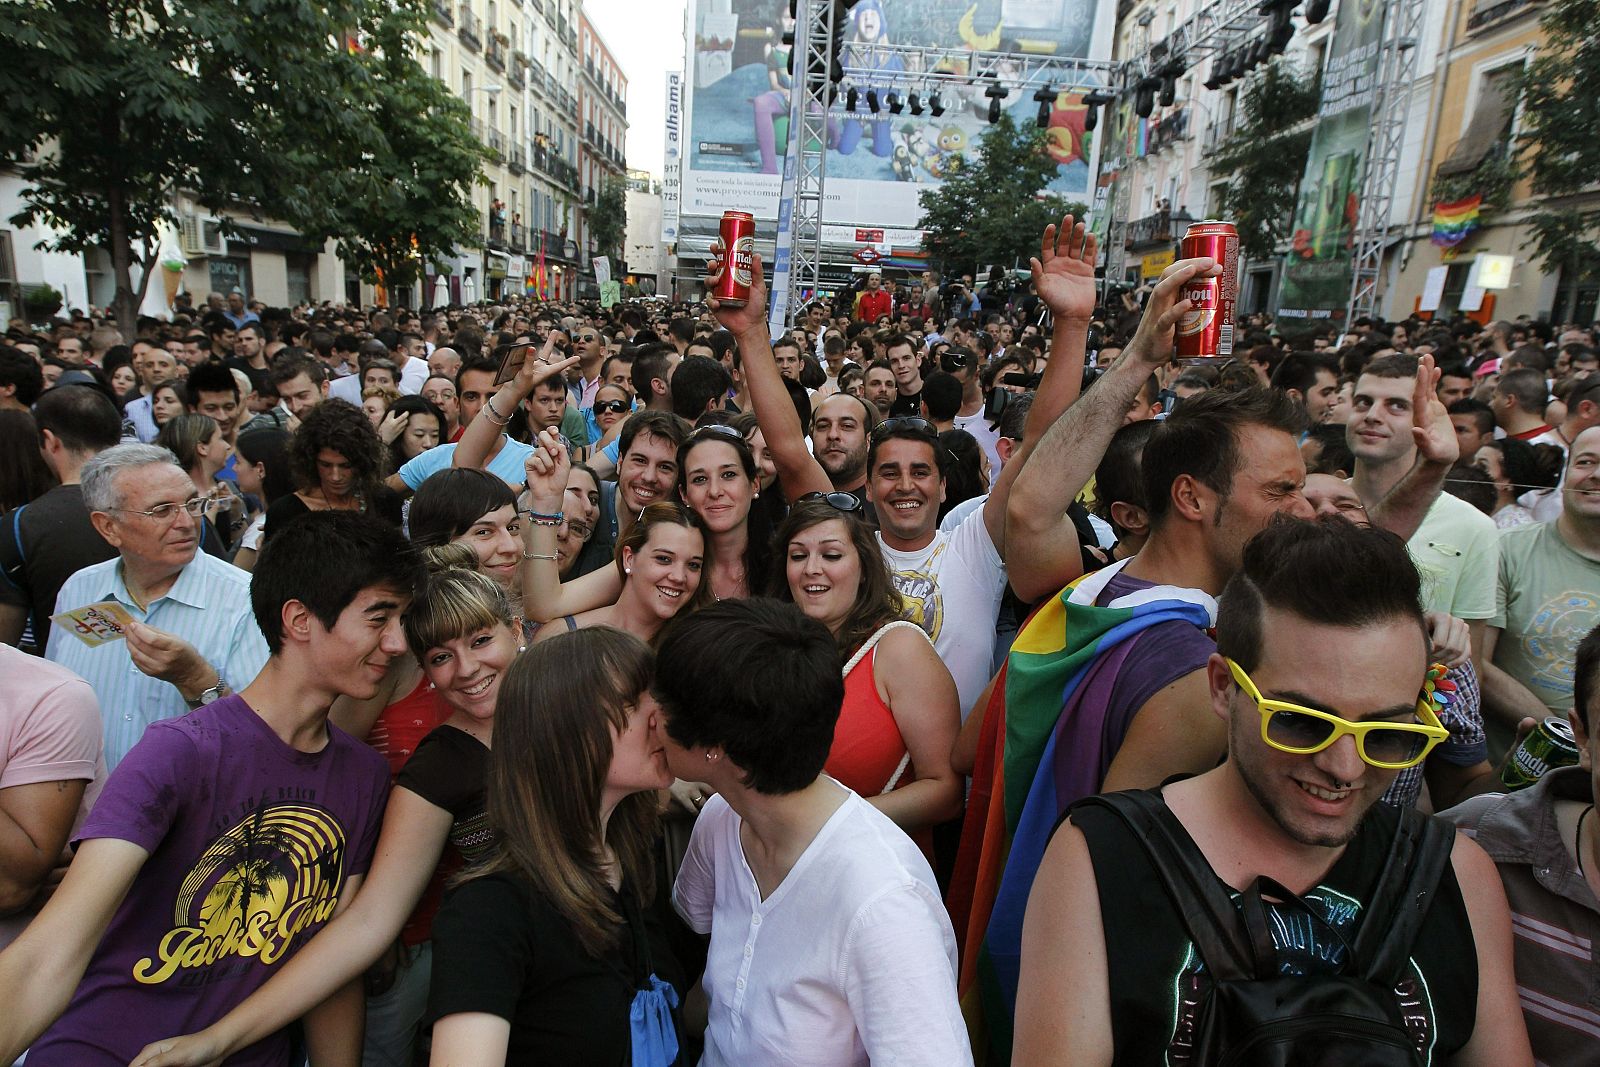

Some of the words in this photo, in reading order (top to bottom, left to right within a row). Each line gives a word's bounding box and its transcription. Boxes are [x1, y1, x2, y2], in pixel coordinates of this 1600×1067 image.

[666, 74, 679, 142] alhama
[664, 164, 678, 173] 917
[664, 179, 678, 187] 130
[735, 252, 753, 263] Mah
[1182, 287, 1213, 301] hou
[1516, 741, 1549, 778] handy
[278, 786, 317, 801] BEACH
